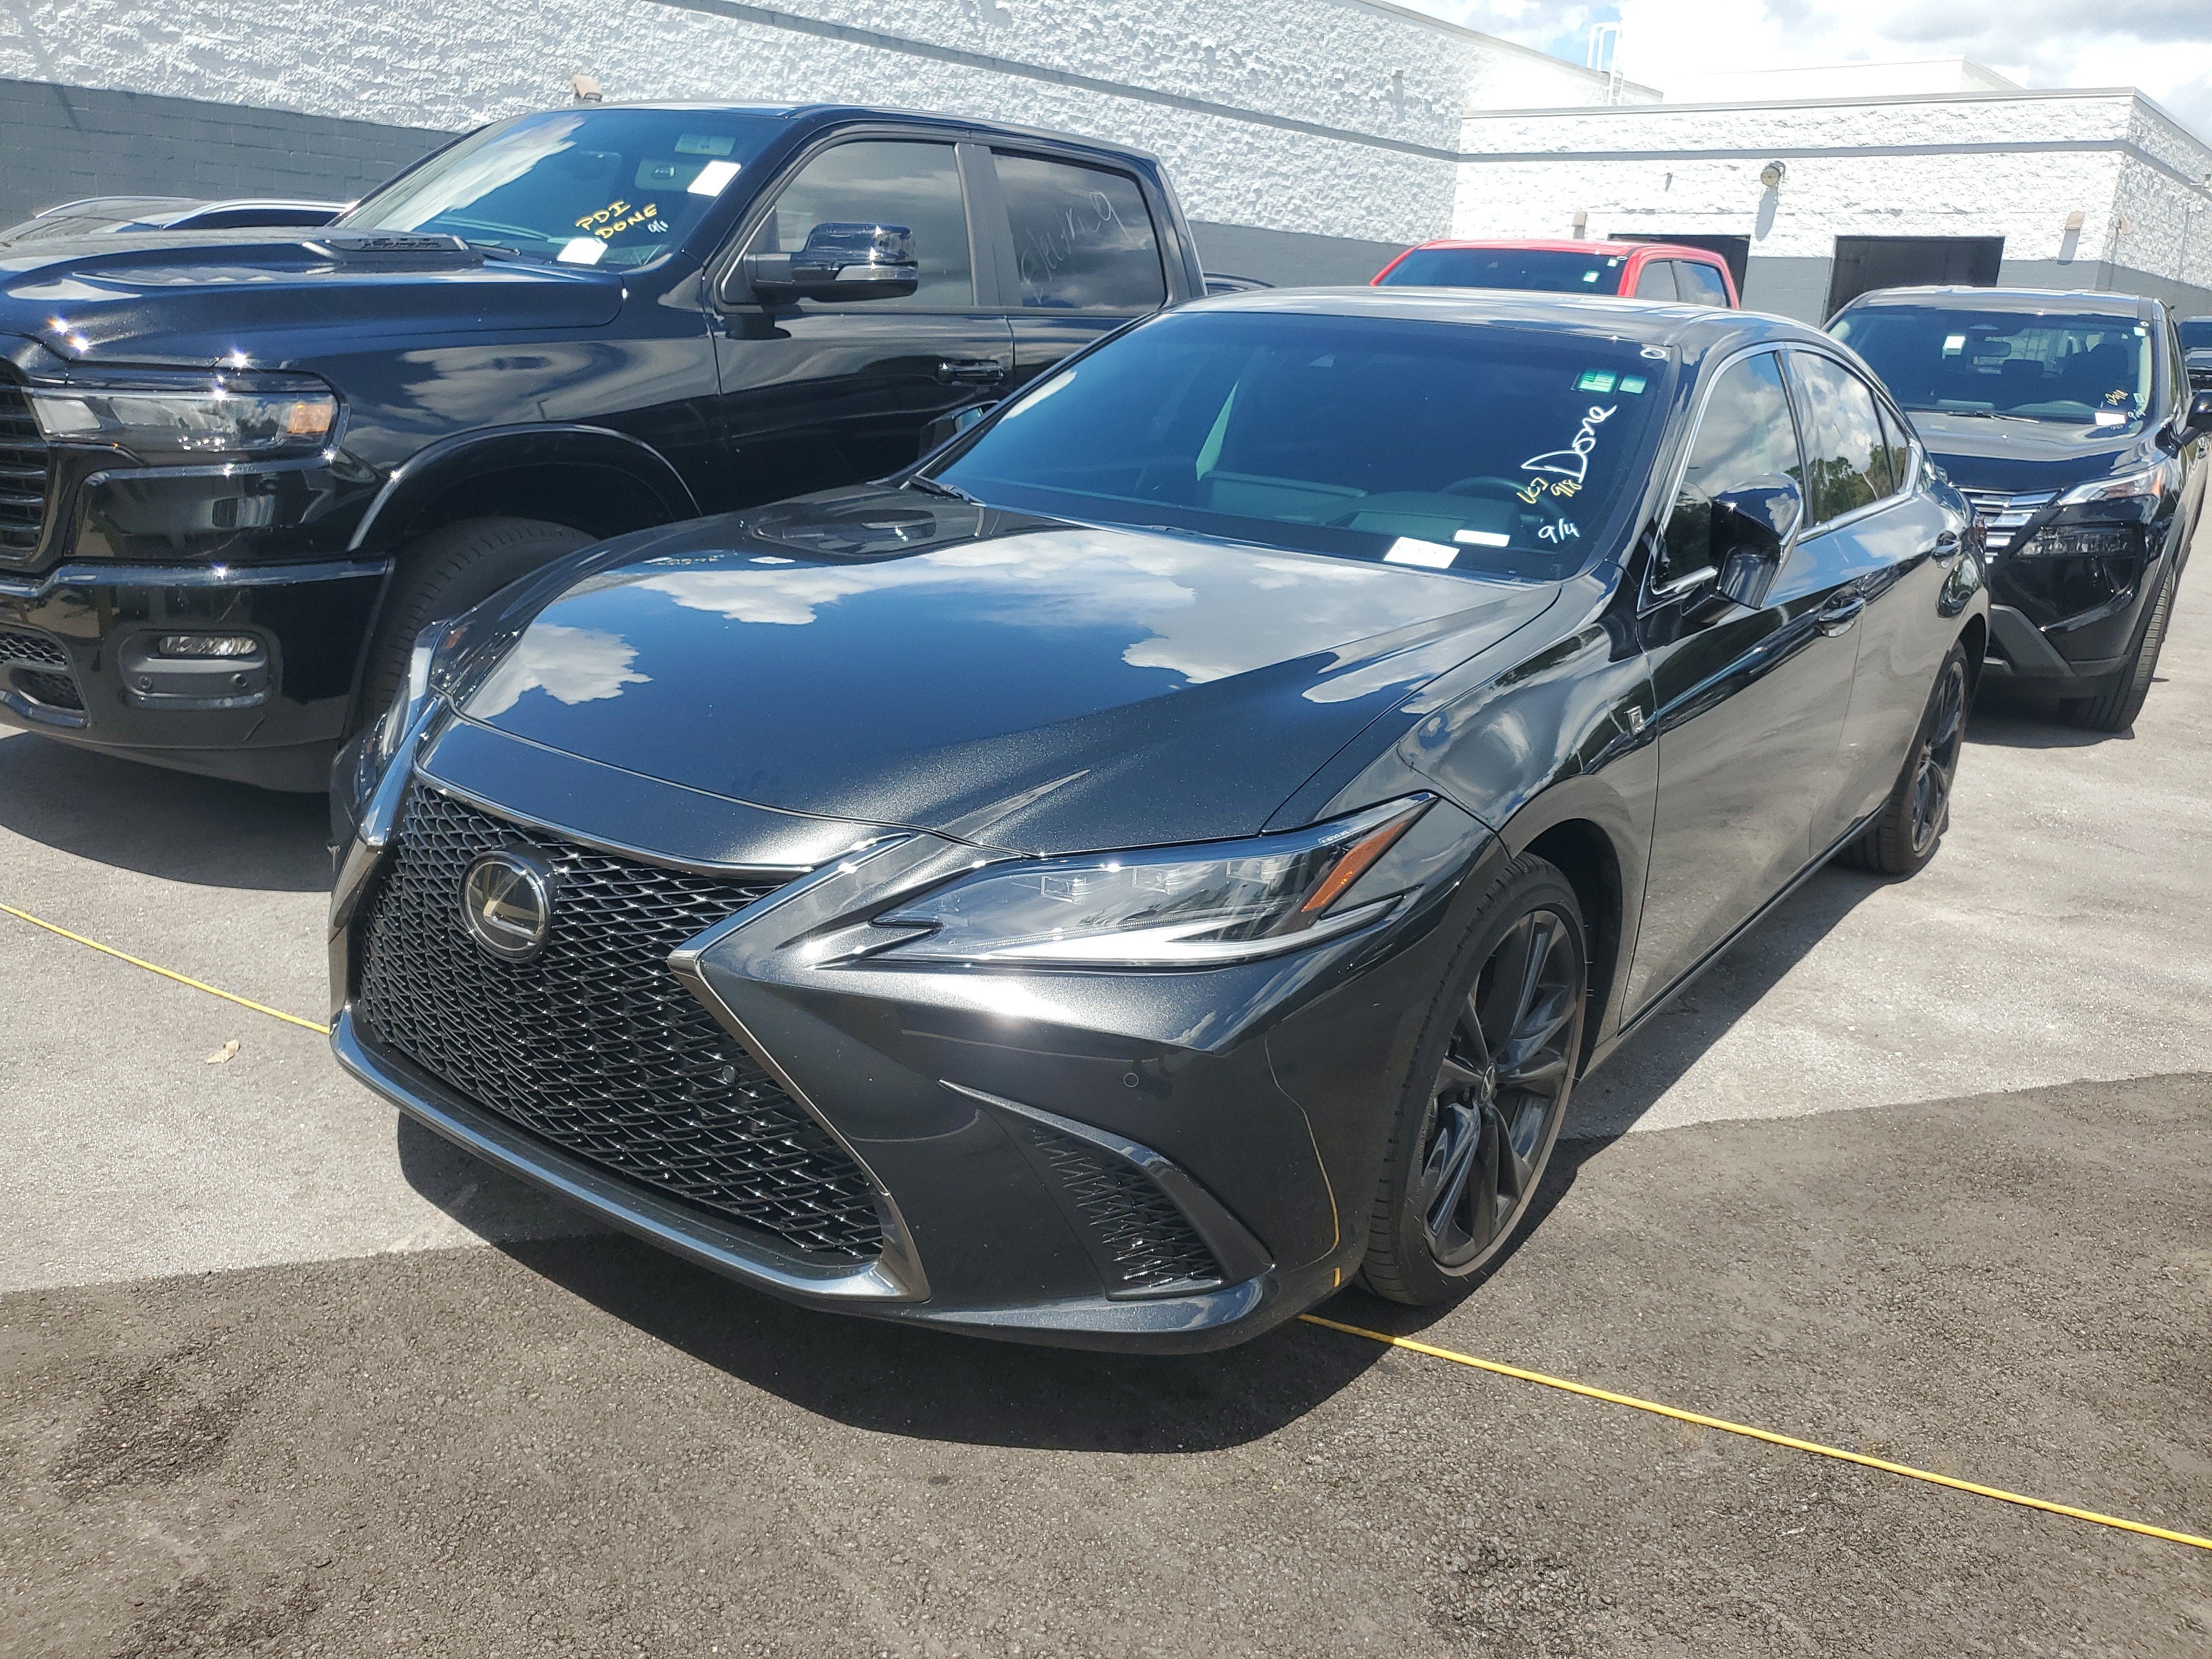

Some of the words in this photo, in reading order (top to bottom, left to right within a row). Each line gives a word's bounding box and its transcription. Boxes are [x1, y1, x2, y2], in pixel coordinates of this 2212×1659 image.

[575, 200, 631, 231] PDI
[595, 203, 657, 239] DONE
[1521, 404, 1618, 483] Done
[1538, 518, 1580, 543] 9/4
